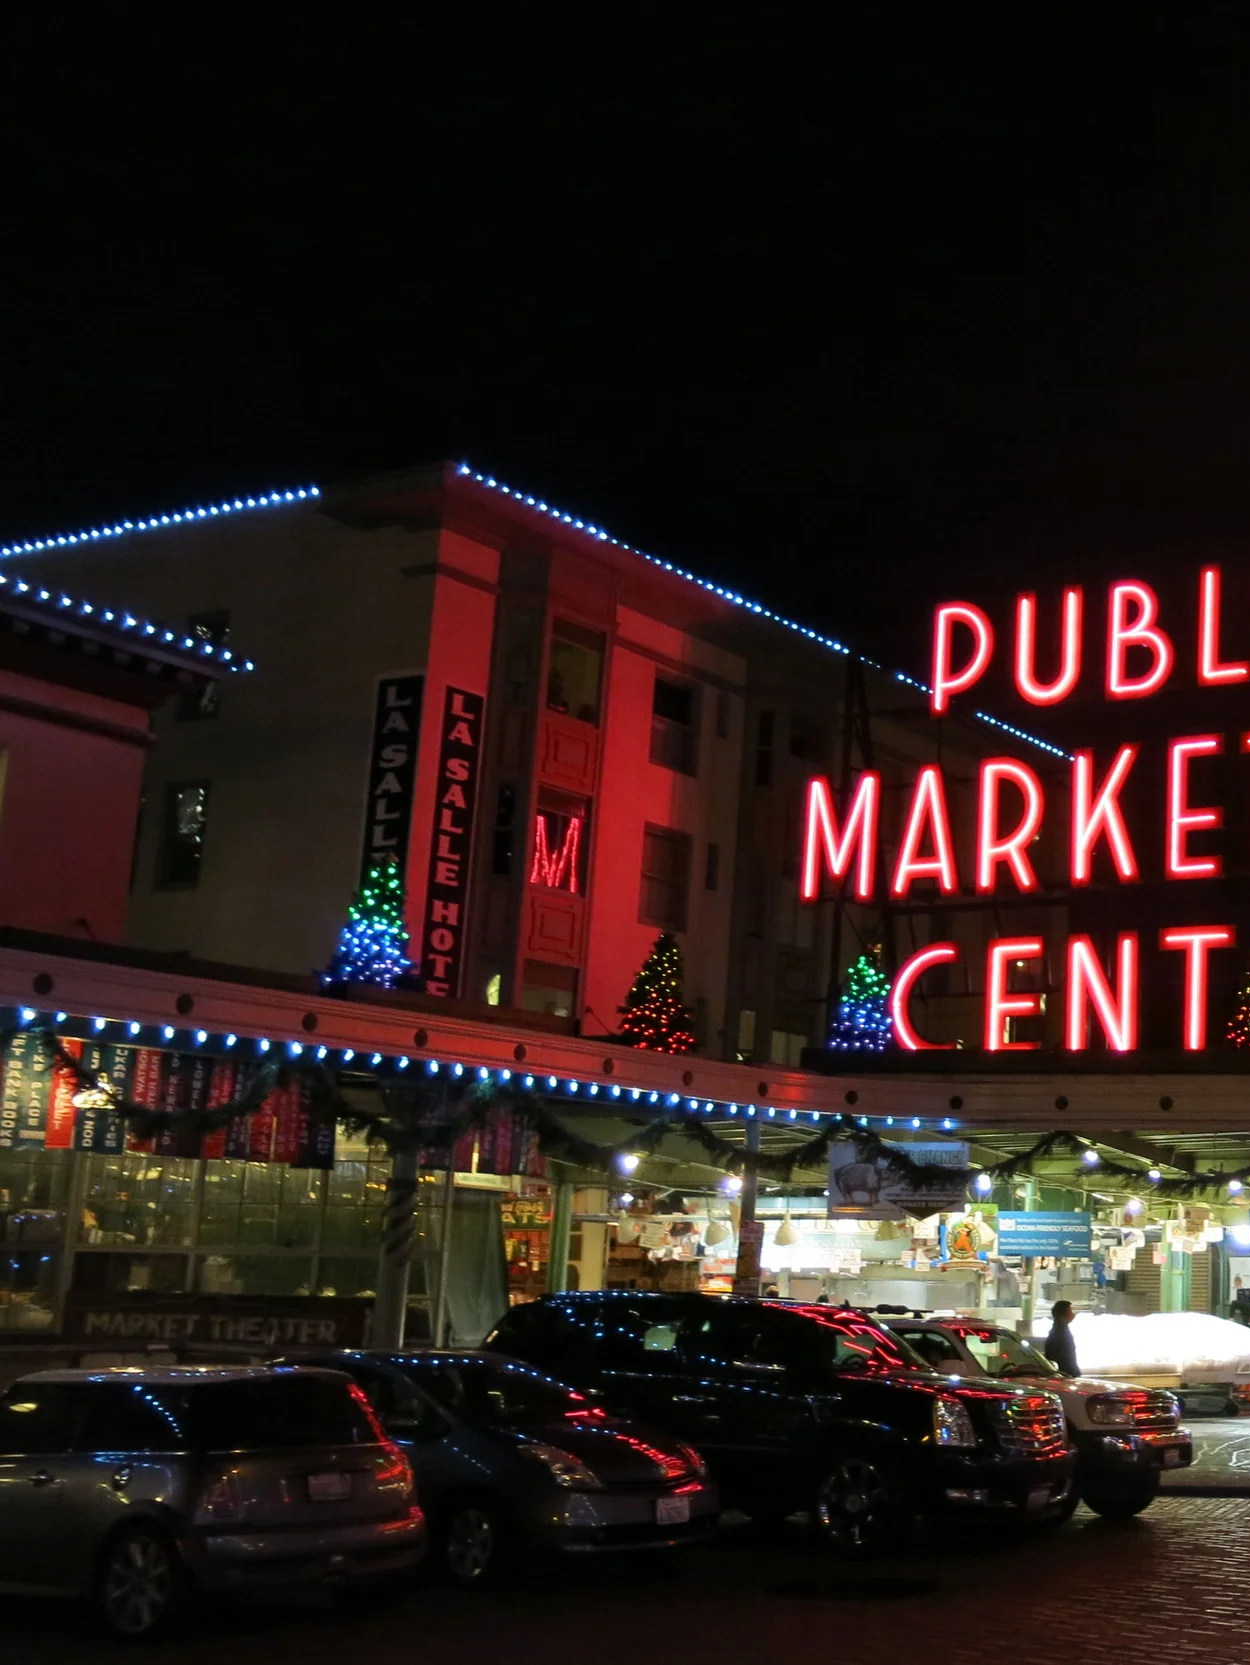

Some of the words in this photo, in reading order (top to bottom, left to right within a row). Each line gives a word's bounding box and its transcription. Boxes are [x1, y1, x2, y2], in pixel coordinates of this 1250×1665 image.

[382, 685, 412, 734] LA
[448, 693, 475, 747] LA
[371, 744, 409, 862] SALL
[436, 758, 470, 887] SALLE
[83, 1311, 202, 1340] MARKET
[208, 1315, 340, 1345] THEATER
